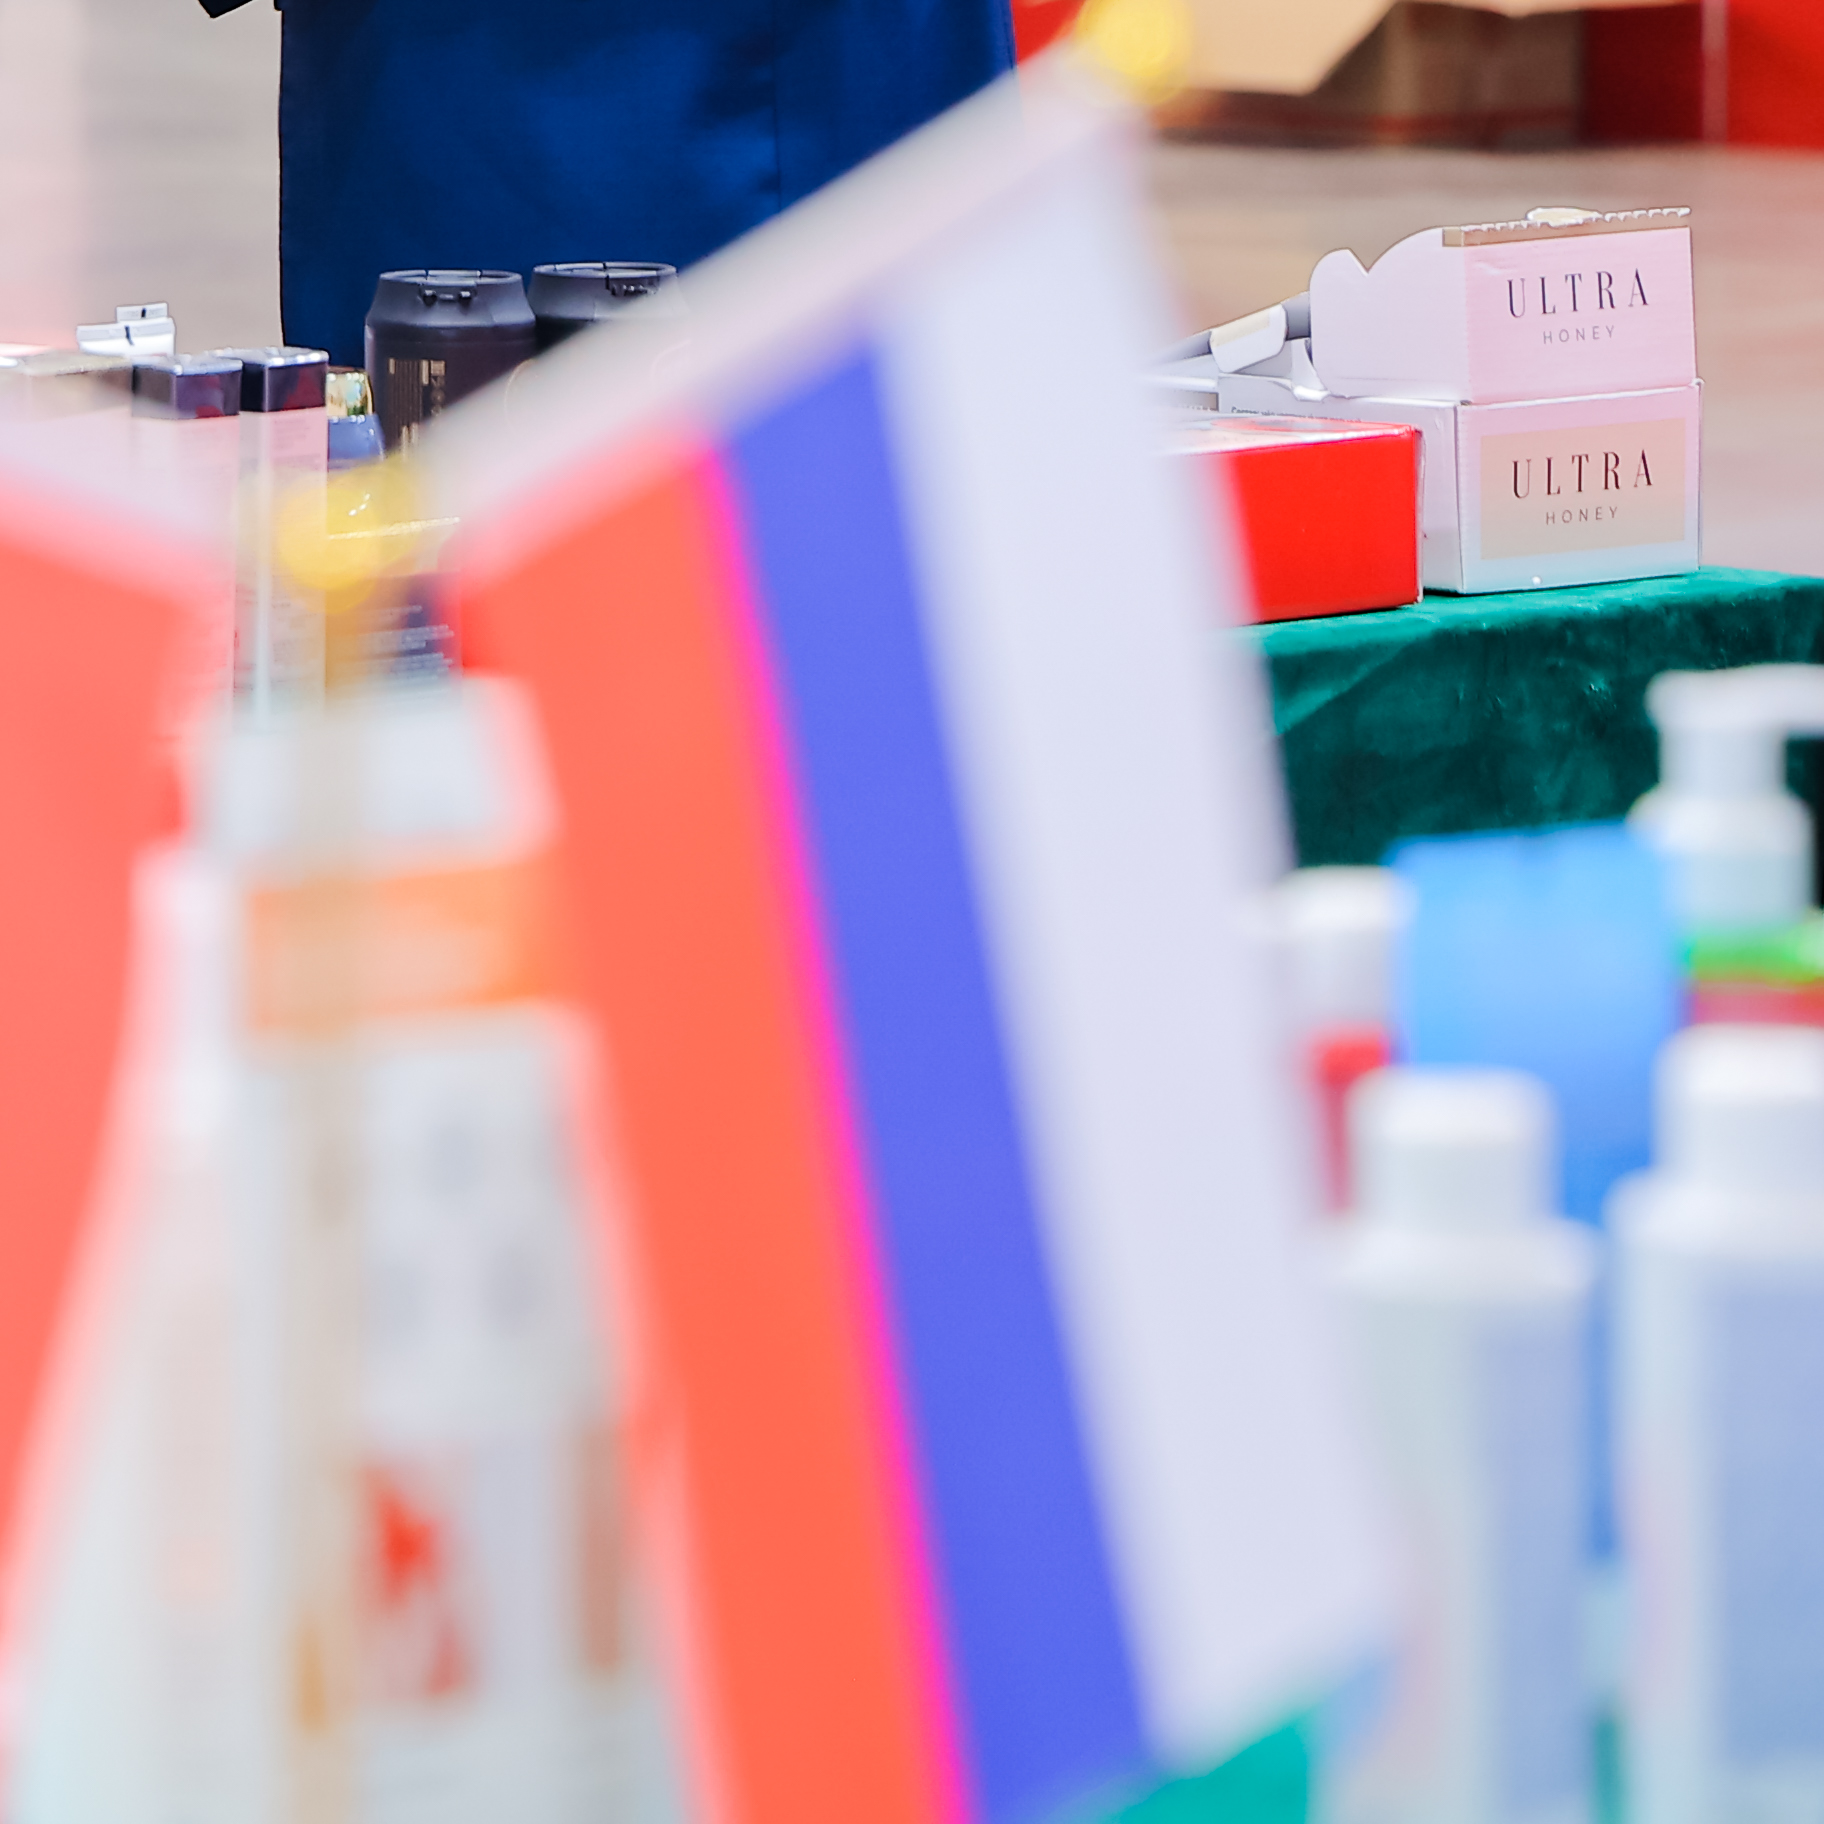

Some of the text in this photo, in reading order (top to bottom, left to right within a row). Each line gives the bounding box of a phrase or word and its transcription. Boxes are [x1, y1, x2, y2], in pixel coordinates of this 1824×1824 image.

[1507, 268, 1650, 319] ULTRA
[1543, 325, 1615, 344] HONEY
[1512, 449, 1654, 499] ULTRA
[1546, 505, 1620, 526] HONEY
